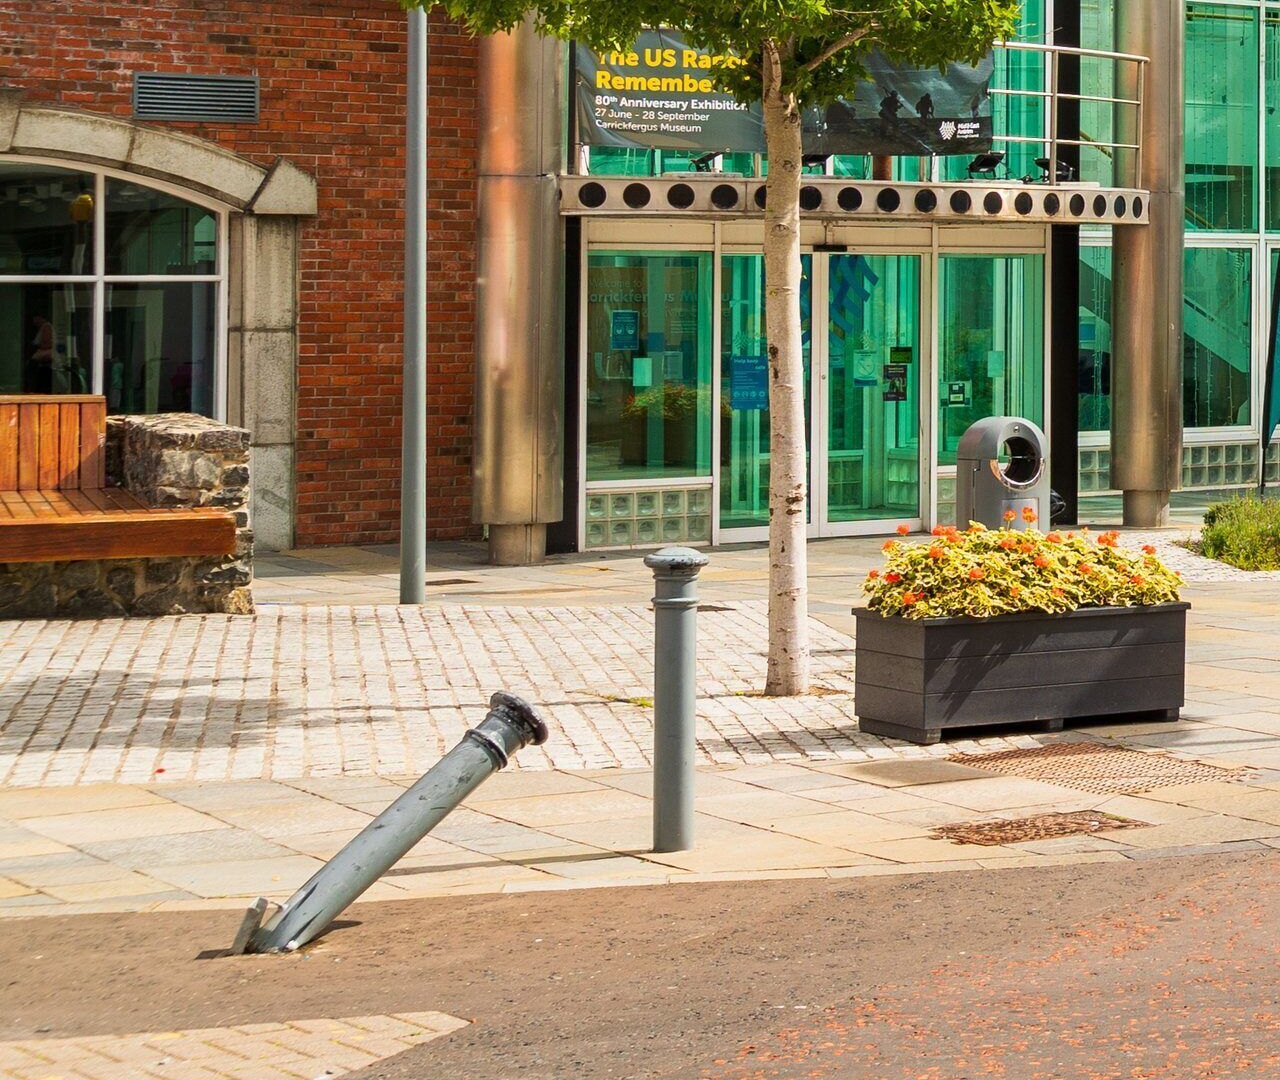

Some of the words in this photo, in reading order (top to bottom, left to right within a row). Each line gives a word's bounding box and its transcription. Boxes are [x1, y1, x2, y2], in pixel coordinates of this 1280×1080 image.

[645, 48, 677, 68] US
[620, 97, 688, 111] Anniversary
[595, 108, 607, 117] 27
[608, 109, 633, 119] June
[642, 111, 655, 120] 28
[657, 111, 710, 122] September
[595, 119, 658, 133] Carrickfergus
[660, 122, 702, 133] Museum
